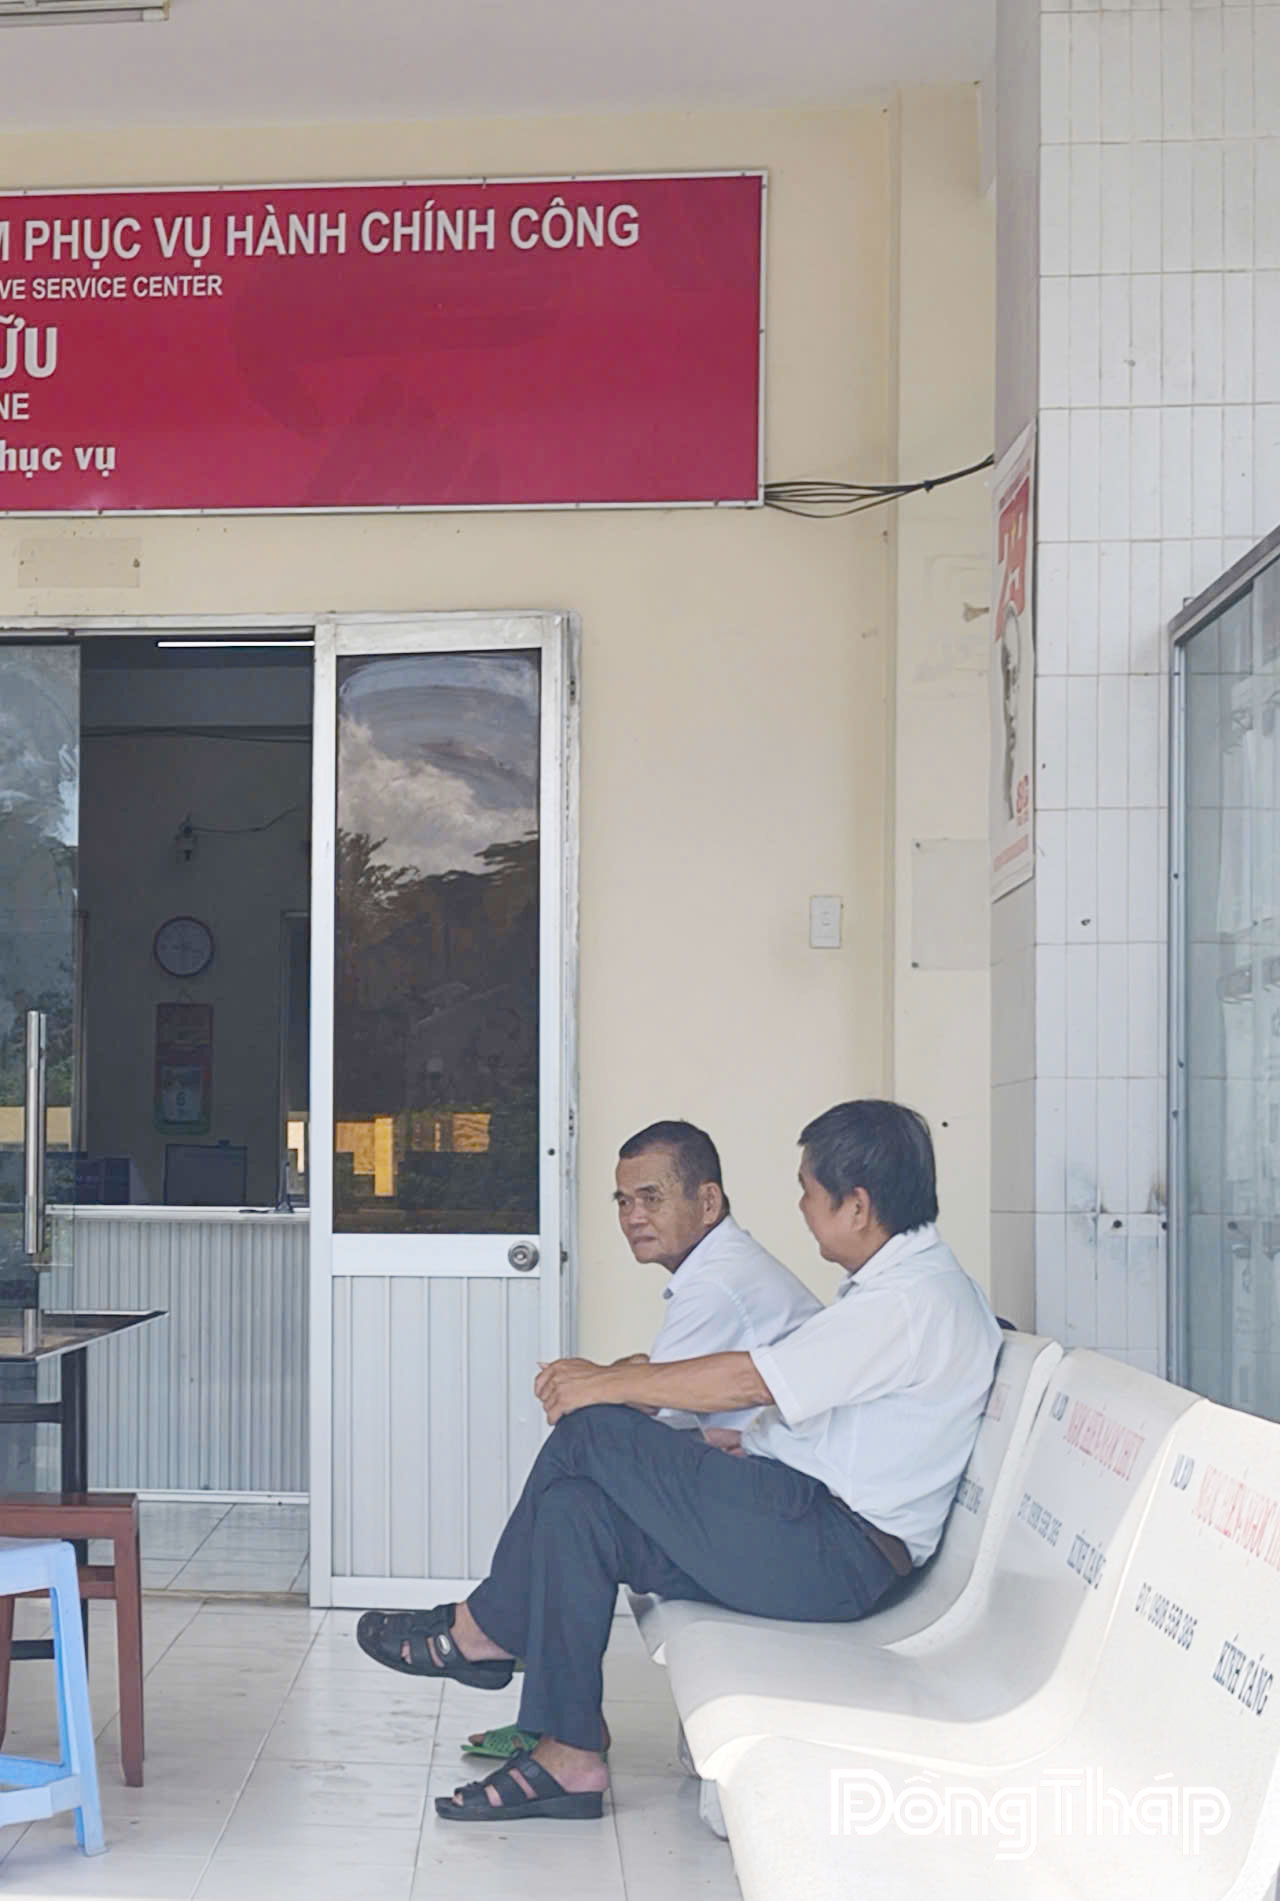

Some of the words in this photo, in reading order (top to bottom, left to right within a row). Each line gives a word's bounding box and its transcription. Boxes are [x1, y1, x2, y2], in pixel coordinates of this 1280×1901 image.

[24, 217, 141, 269] PHỤC
[154, 216, 210, 267] VỤ
[227, 205, 346, 256] HÀNH
[361, 200, 495, 252] CHÍNH
[511, 197, 639, 249] CÔNG
[32, 277, 126, 299] SERVICE
[133, 275, 222, 297] CENTER
[75, 446, 116, 477] vụ
